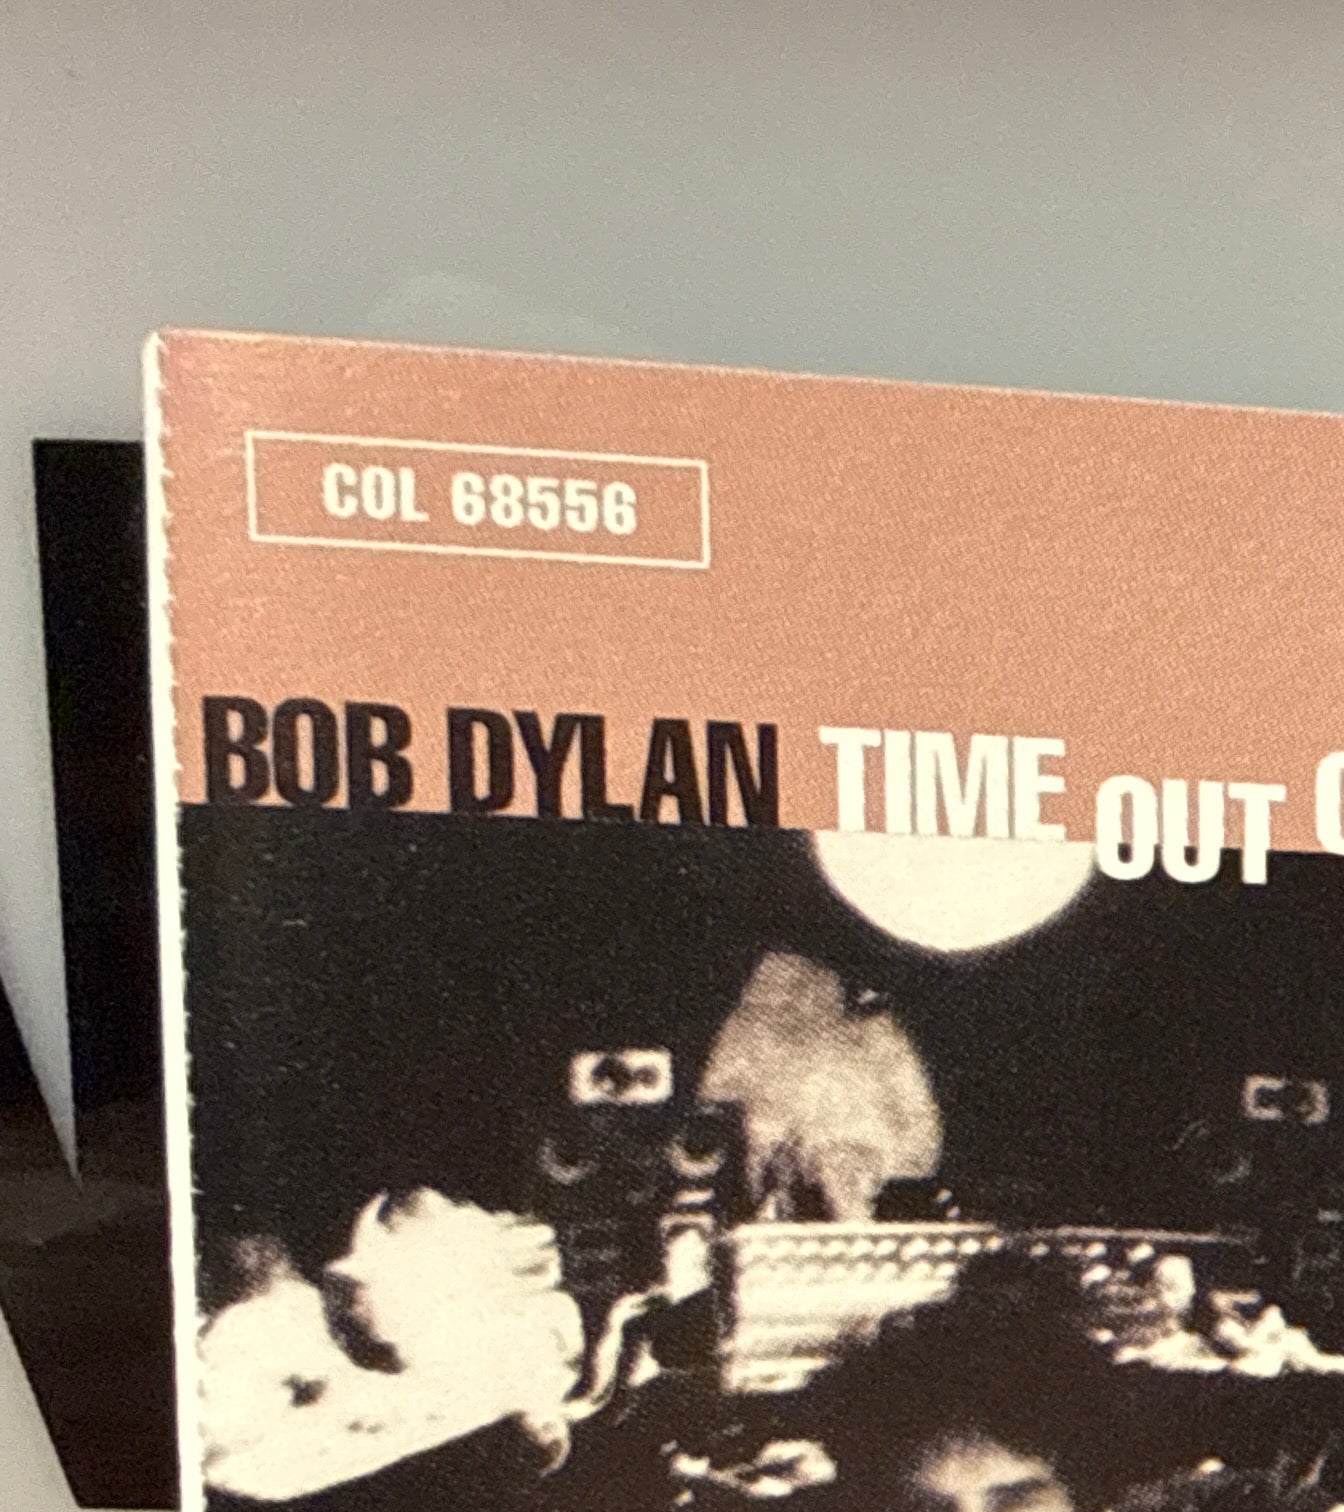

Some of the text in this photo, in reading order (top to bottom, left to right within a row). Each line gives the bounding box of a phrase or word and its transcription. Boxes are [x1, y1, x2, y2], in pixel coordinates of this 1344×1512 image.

[322, 462, 638, 535] COL 68556
[202, 695, 414, 810] BOB
[445, 705, 780, 826] DYLAN
[817, 725, 1067, 843] TIME
[1096, 773, 1287, 885] OUT
